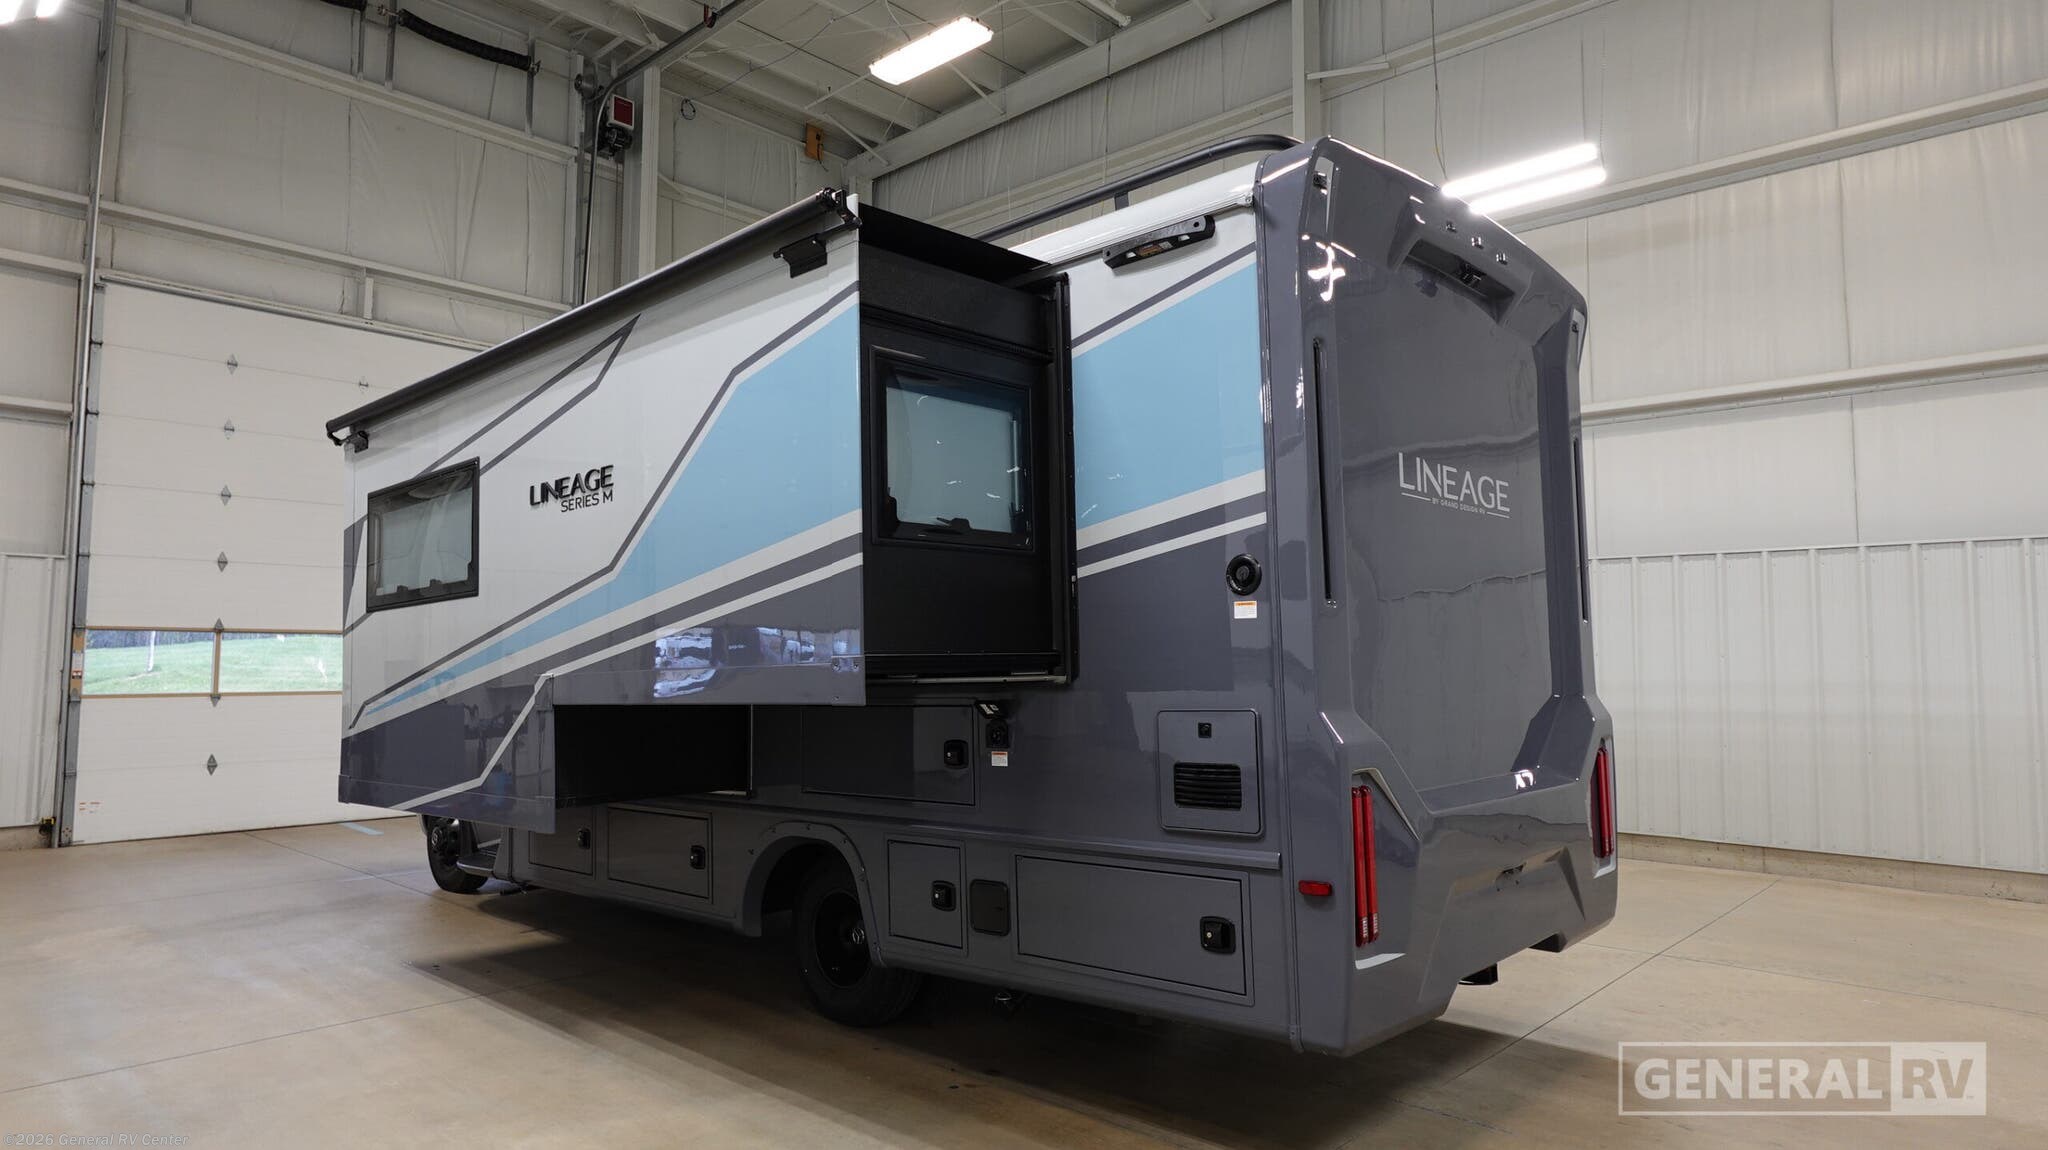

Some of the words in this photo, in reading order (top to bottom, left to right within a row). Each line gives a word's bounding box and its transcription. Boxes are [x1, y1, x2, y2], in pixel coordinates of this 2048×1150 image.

[530, 464, 614, 506] LINEAGE
[561, 492, 600, 513] SERIES
[602, 488, 613, 503] M
[1399, 452, 1510, 512] LINEAGE
